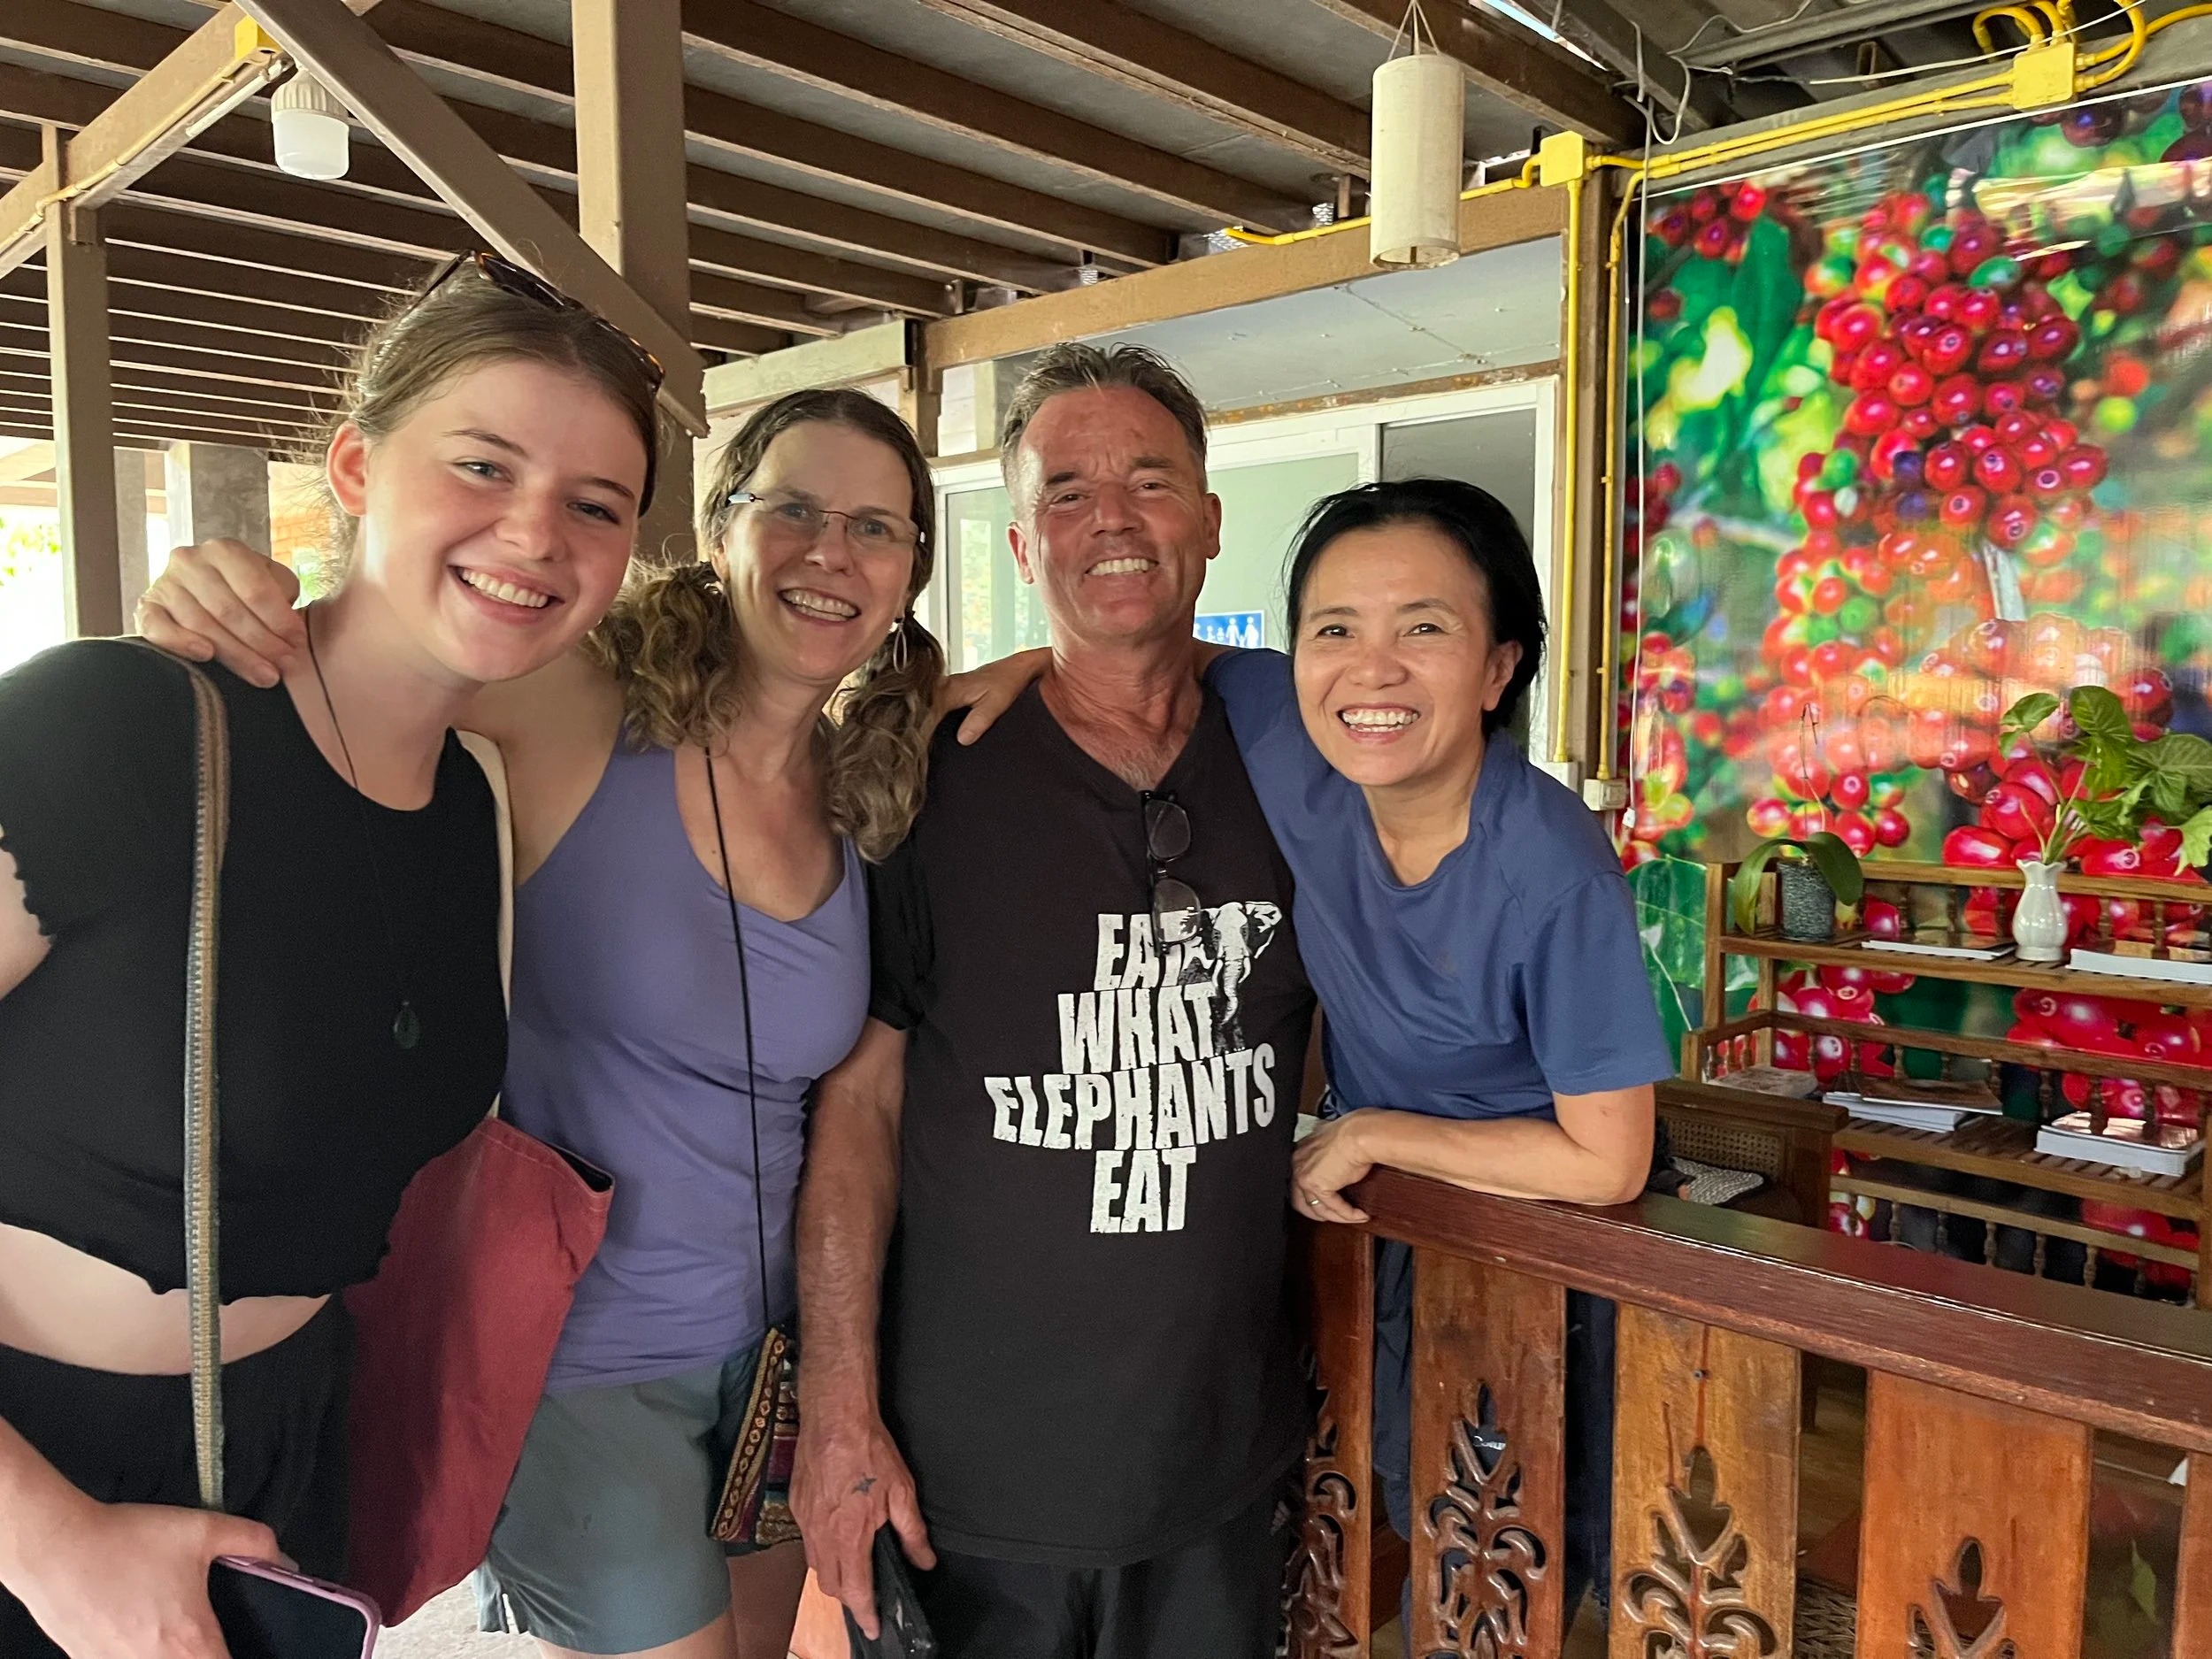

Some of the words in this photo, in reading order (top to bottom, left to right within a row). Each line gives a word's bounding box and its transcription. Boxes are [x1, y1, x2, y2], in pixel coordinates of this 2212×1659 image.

[1094, 910, 1199, 991] EAT
[1057, 981, 1216, 1074] WHAT
[984, 1043, 1275, 1150] ELEPHANTS
[1090, 1147, 1196, 1233] EAT
